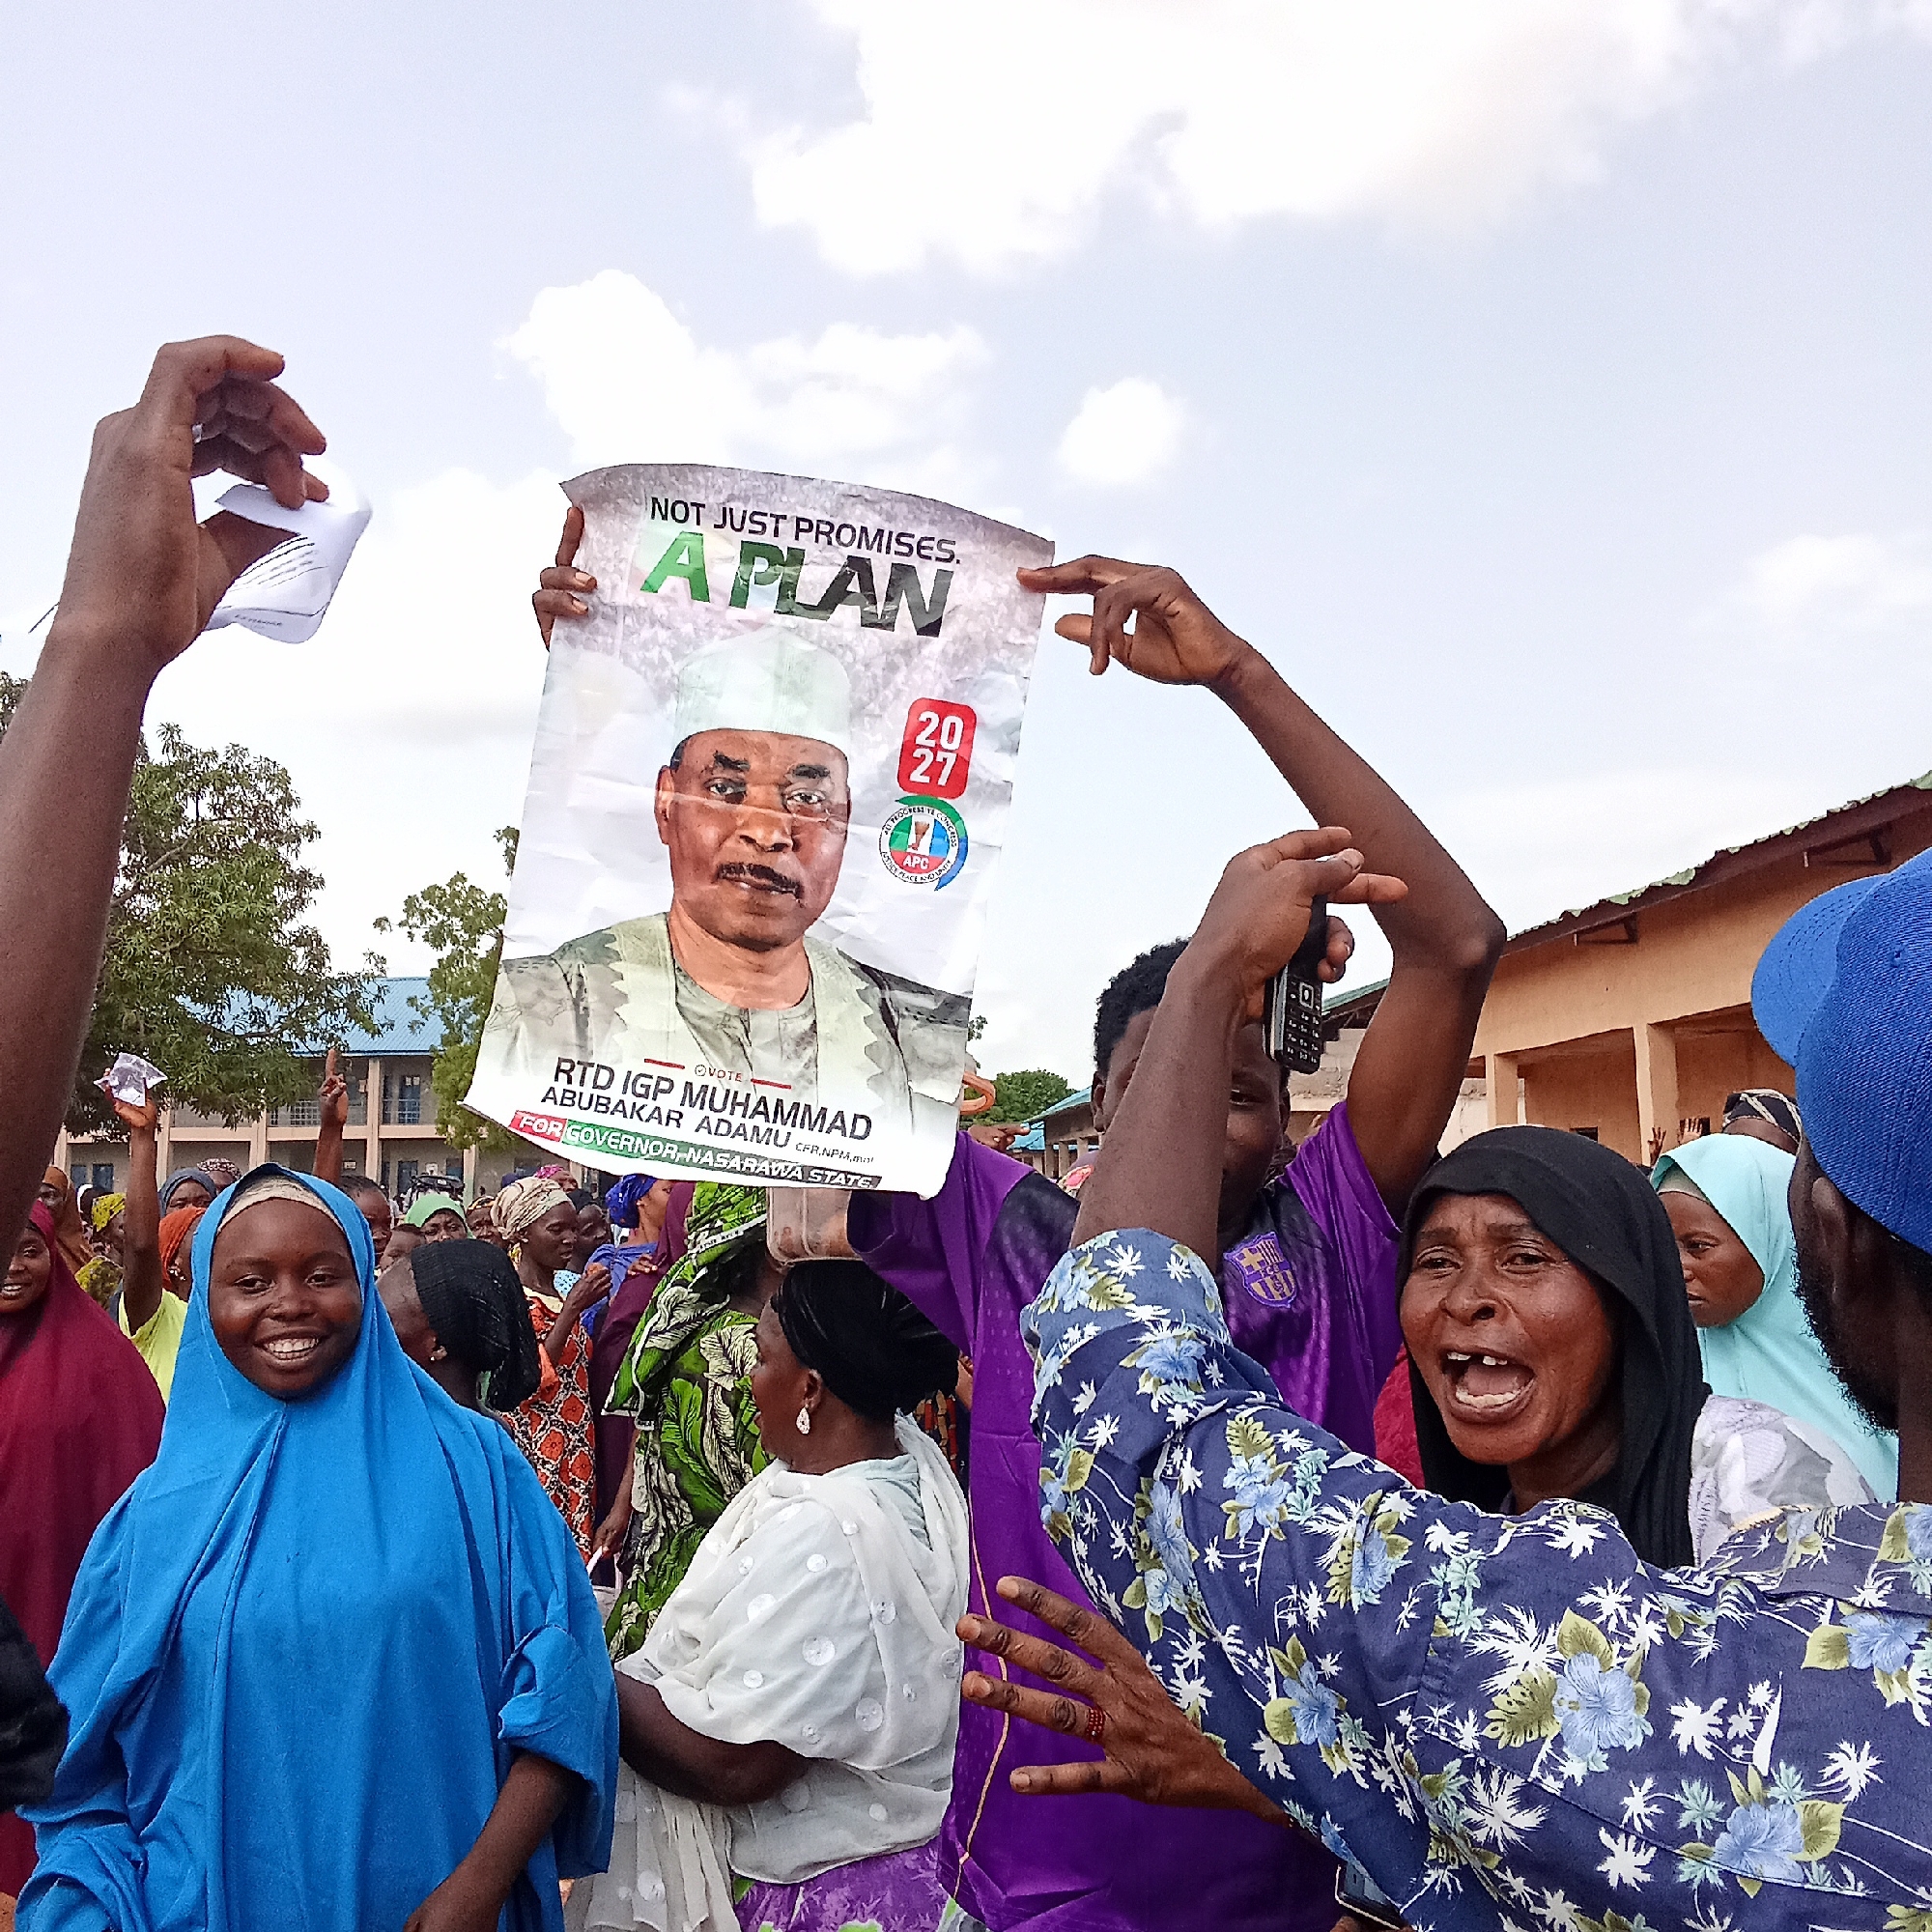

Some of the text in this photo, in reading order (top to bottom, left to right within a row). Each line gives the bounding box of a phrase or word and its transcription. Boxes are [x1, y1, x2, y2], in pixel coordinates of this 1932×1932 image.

[650, 497, 961, 565] NOT JUST PROMISES.
[639, 530, 954, 638] A PLAN
[915, 710, 964, 751] 20
[909, 748, 957, 786] 27
[902, 854, 929, 870] APC
[554, 1056, 872, 1141] RTD IGP MUHAMMAD
[708, 1066, 743, 1083] VOTE
[519, 1114, 563, 1138] FOR
[685, 1146, 804, 1180] NASARAWA
[540, 1086, 684, 1128] ABUBAKAR
[694, 1115, 792, 1149] ADAMU
